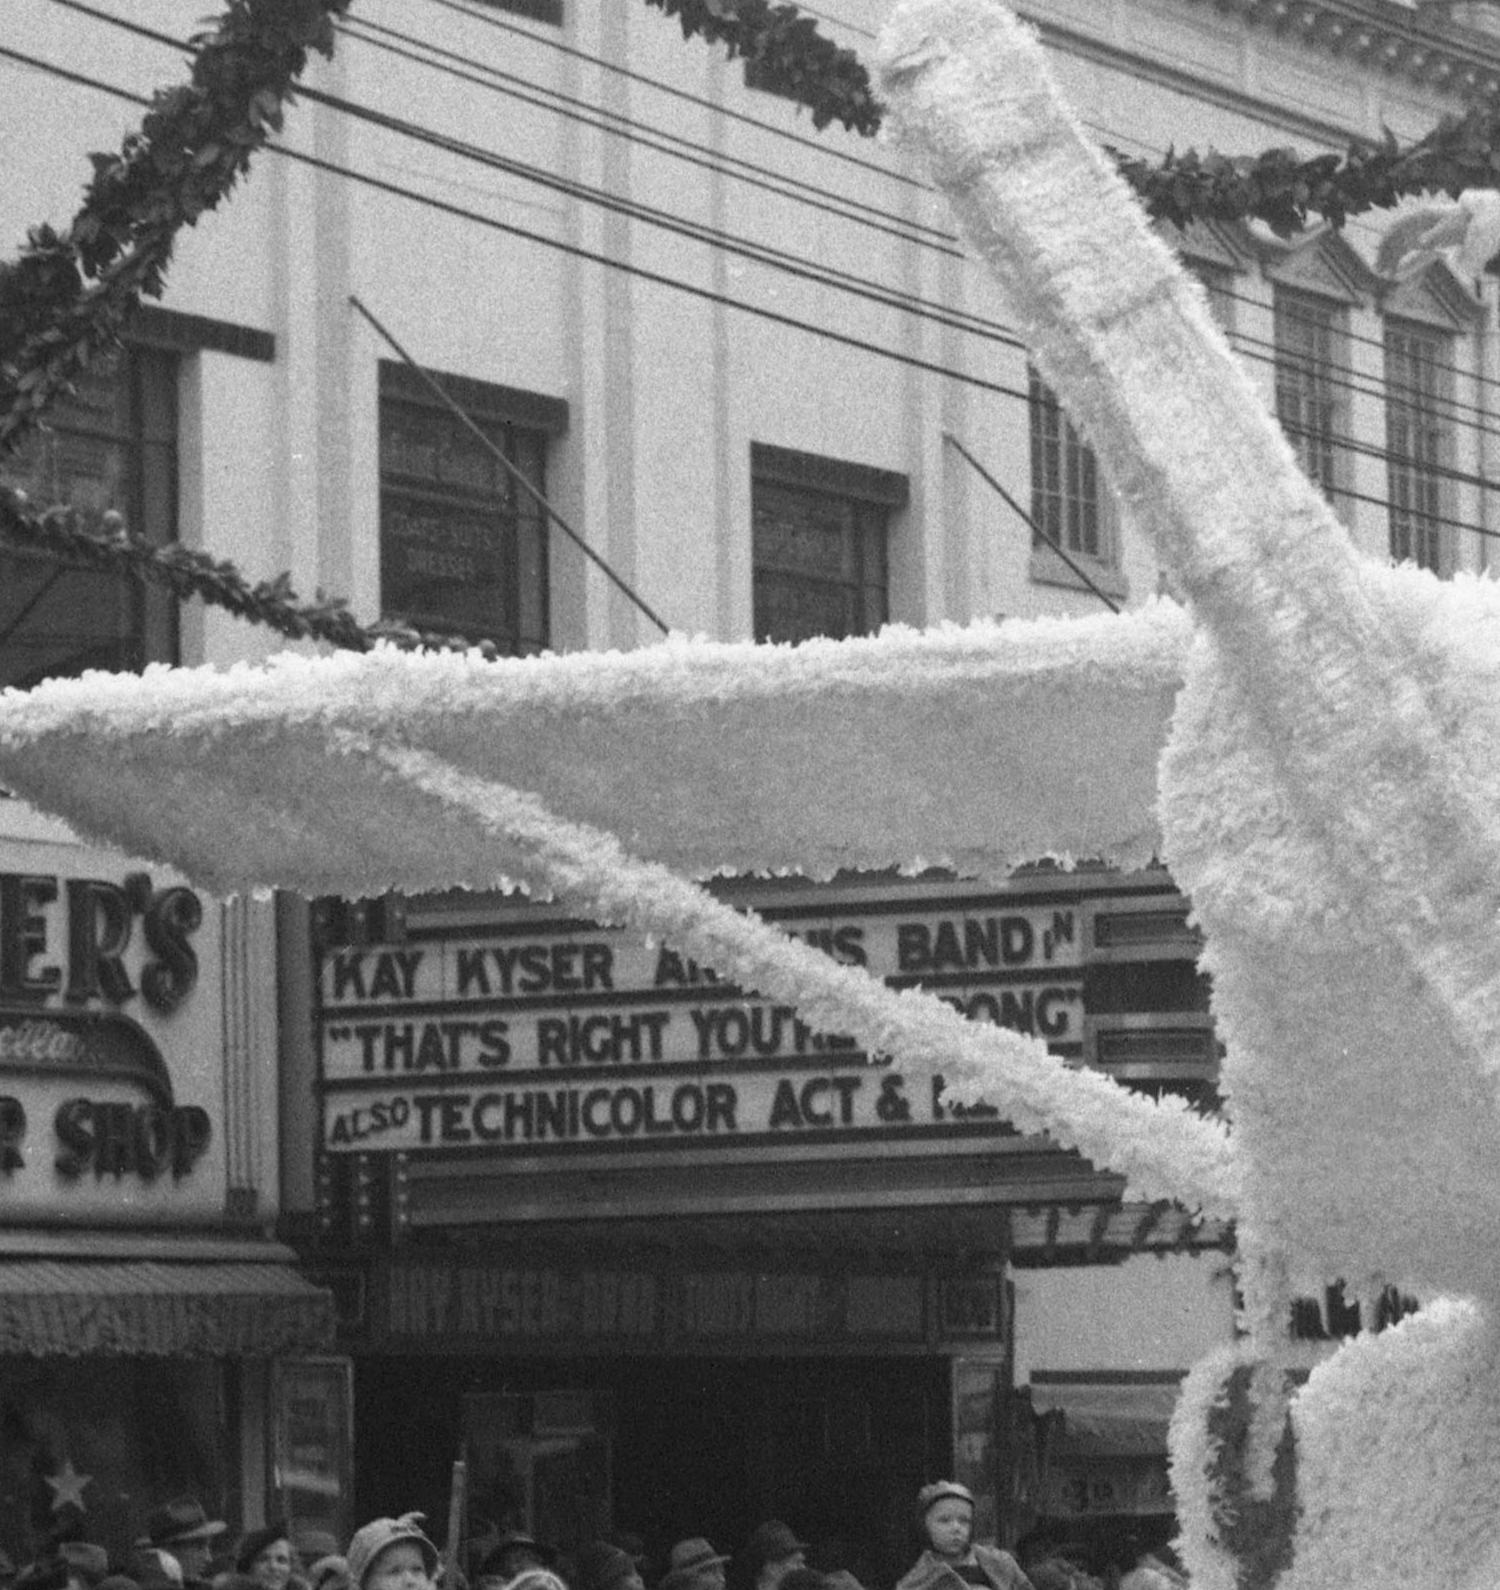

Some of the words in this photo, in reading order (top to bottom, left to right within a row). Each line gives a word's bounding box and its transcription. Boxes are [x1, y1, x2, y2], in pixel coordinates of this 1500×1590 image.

[332, 949, 424, 1002] KAY
[457, 942, 614, 996] KYSER
[900, 917, 1033, 971] BAND
[1043, 910, 1074, 961] IN
[538, 1012, 671, 1066] RIGHT
[55, 1097, 212, 1183] SHOP
[330, 1097, 410, 1146] ALSO
[412, 1080, 738, 1144] TECHNICOLOR
[769, 1074, 862, 1128] ACT
[876, 1073, 911, 1122] &
